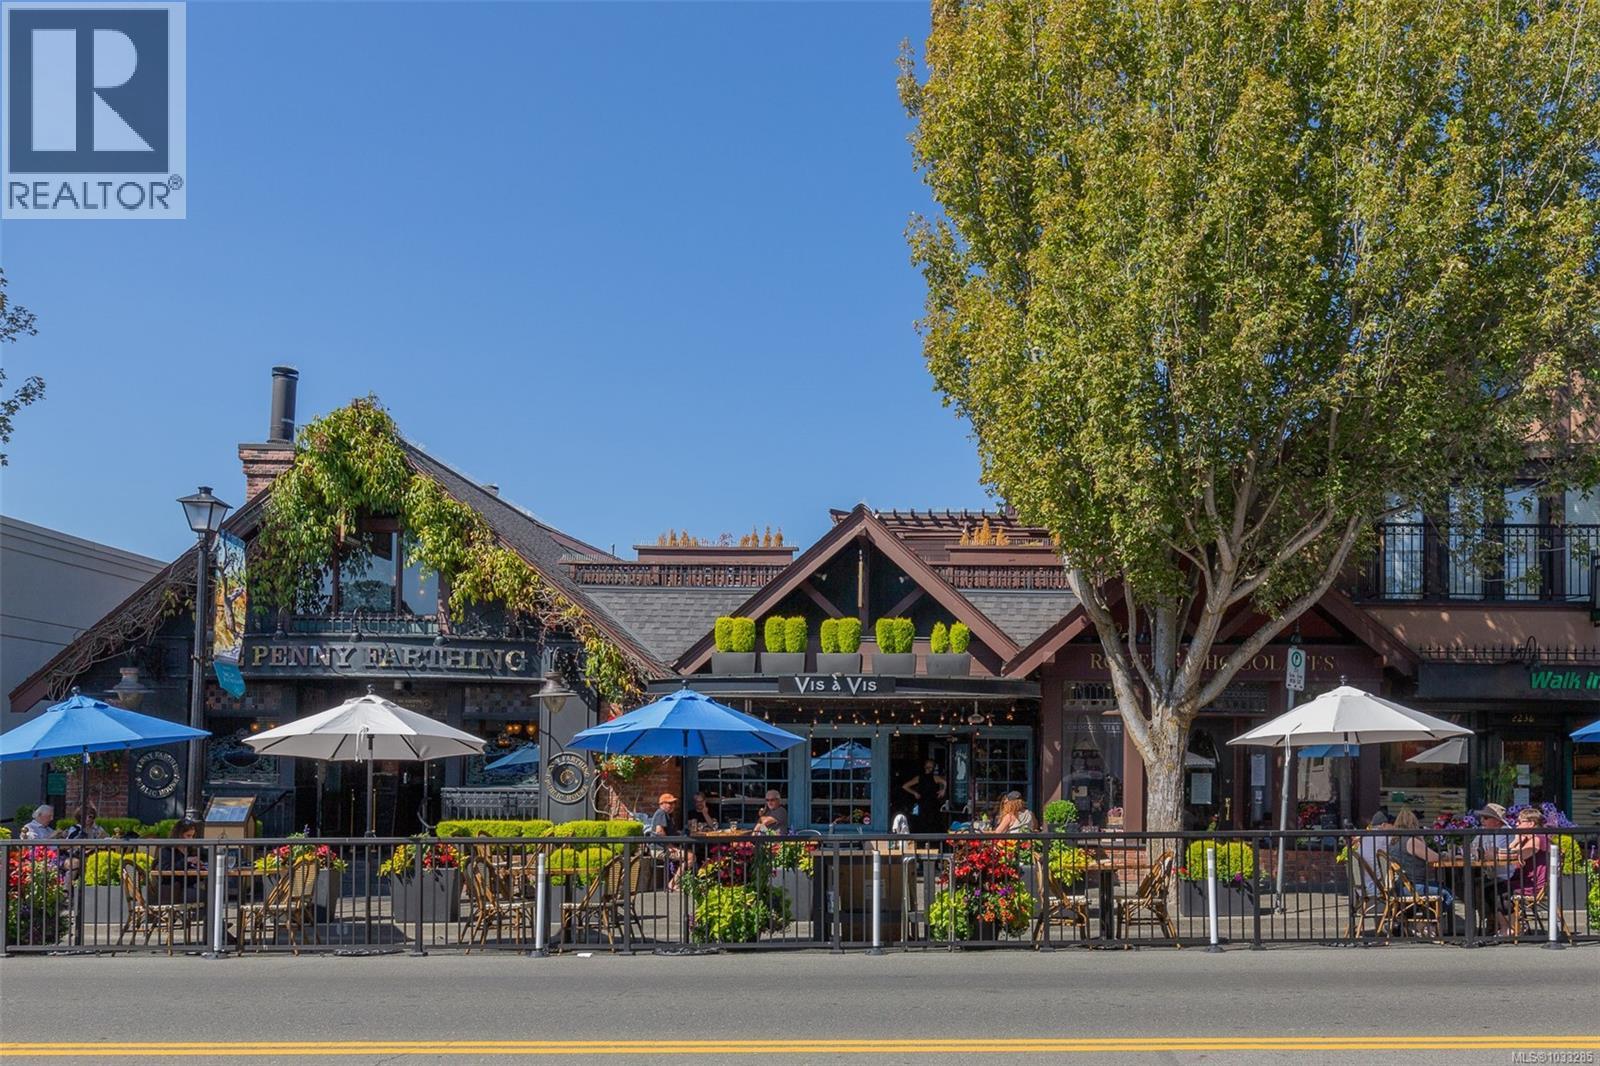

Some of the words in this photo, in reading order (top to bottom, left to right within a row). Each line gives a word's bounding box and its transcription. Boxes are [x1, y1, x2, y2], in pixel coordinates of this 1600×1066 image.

[252, 644, 351, 667] PENNY
[365, 648, 528, 671] FARTHING
[794, 676, 825, 695] Vis
[846, 677, 877, 695] Vis
[1531, 671, 1581, 689] Walk
